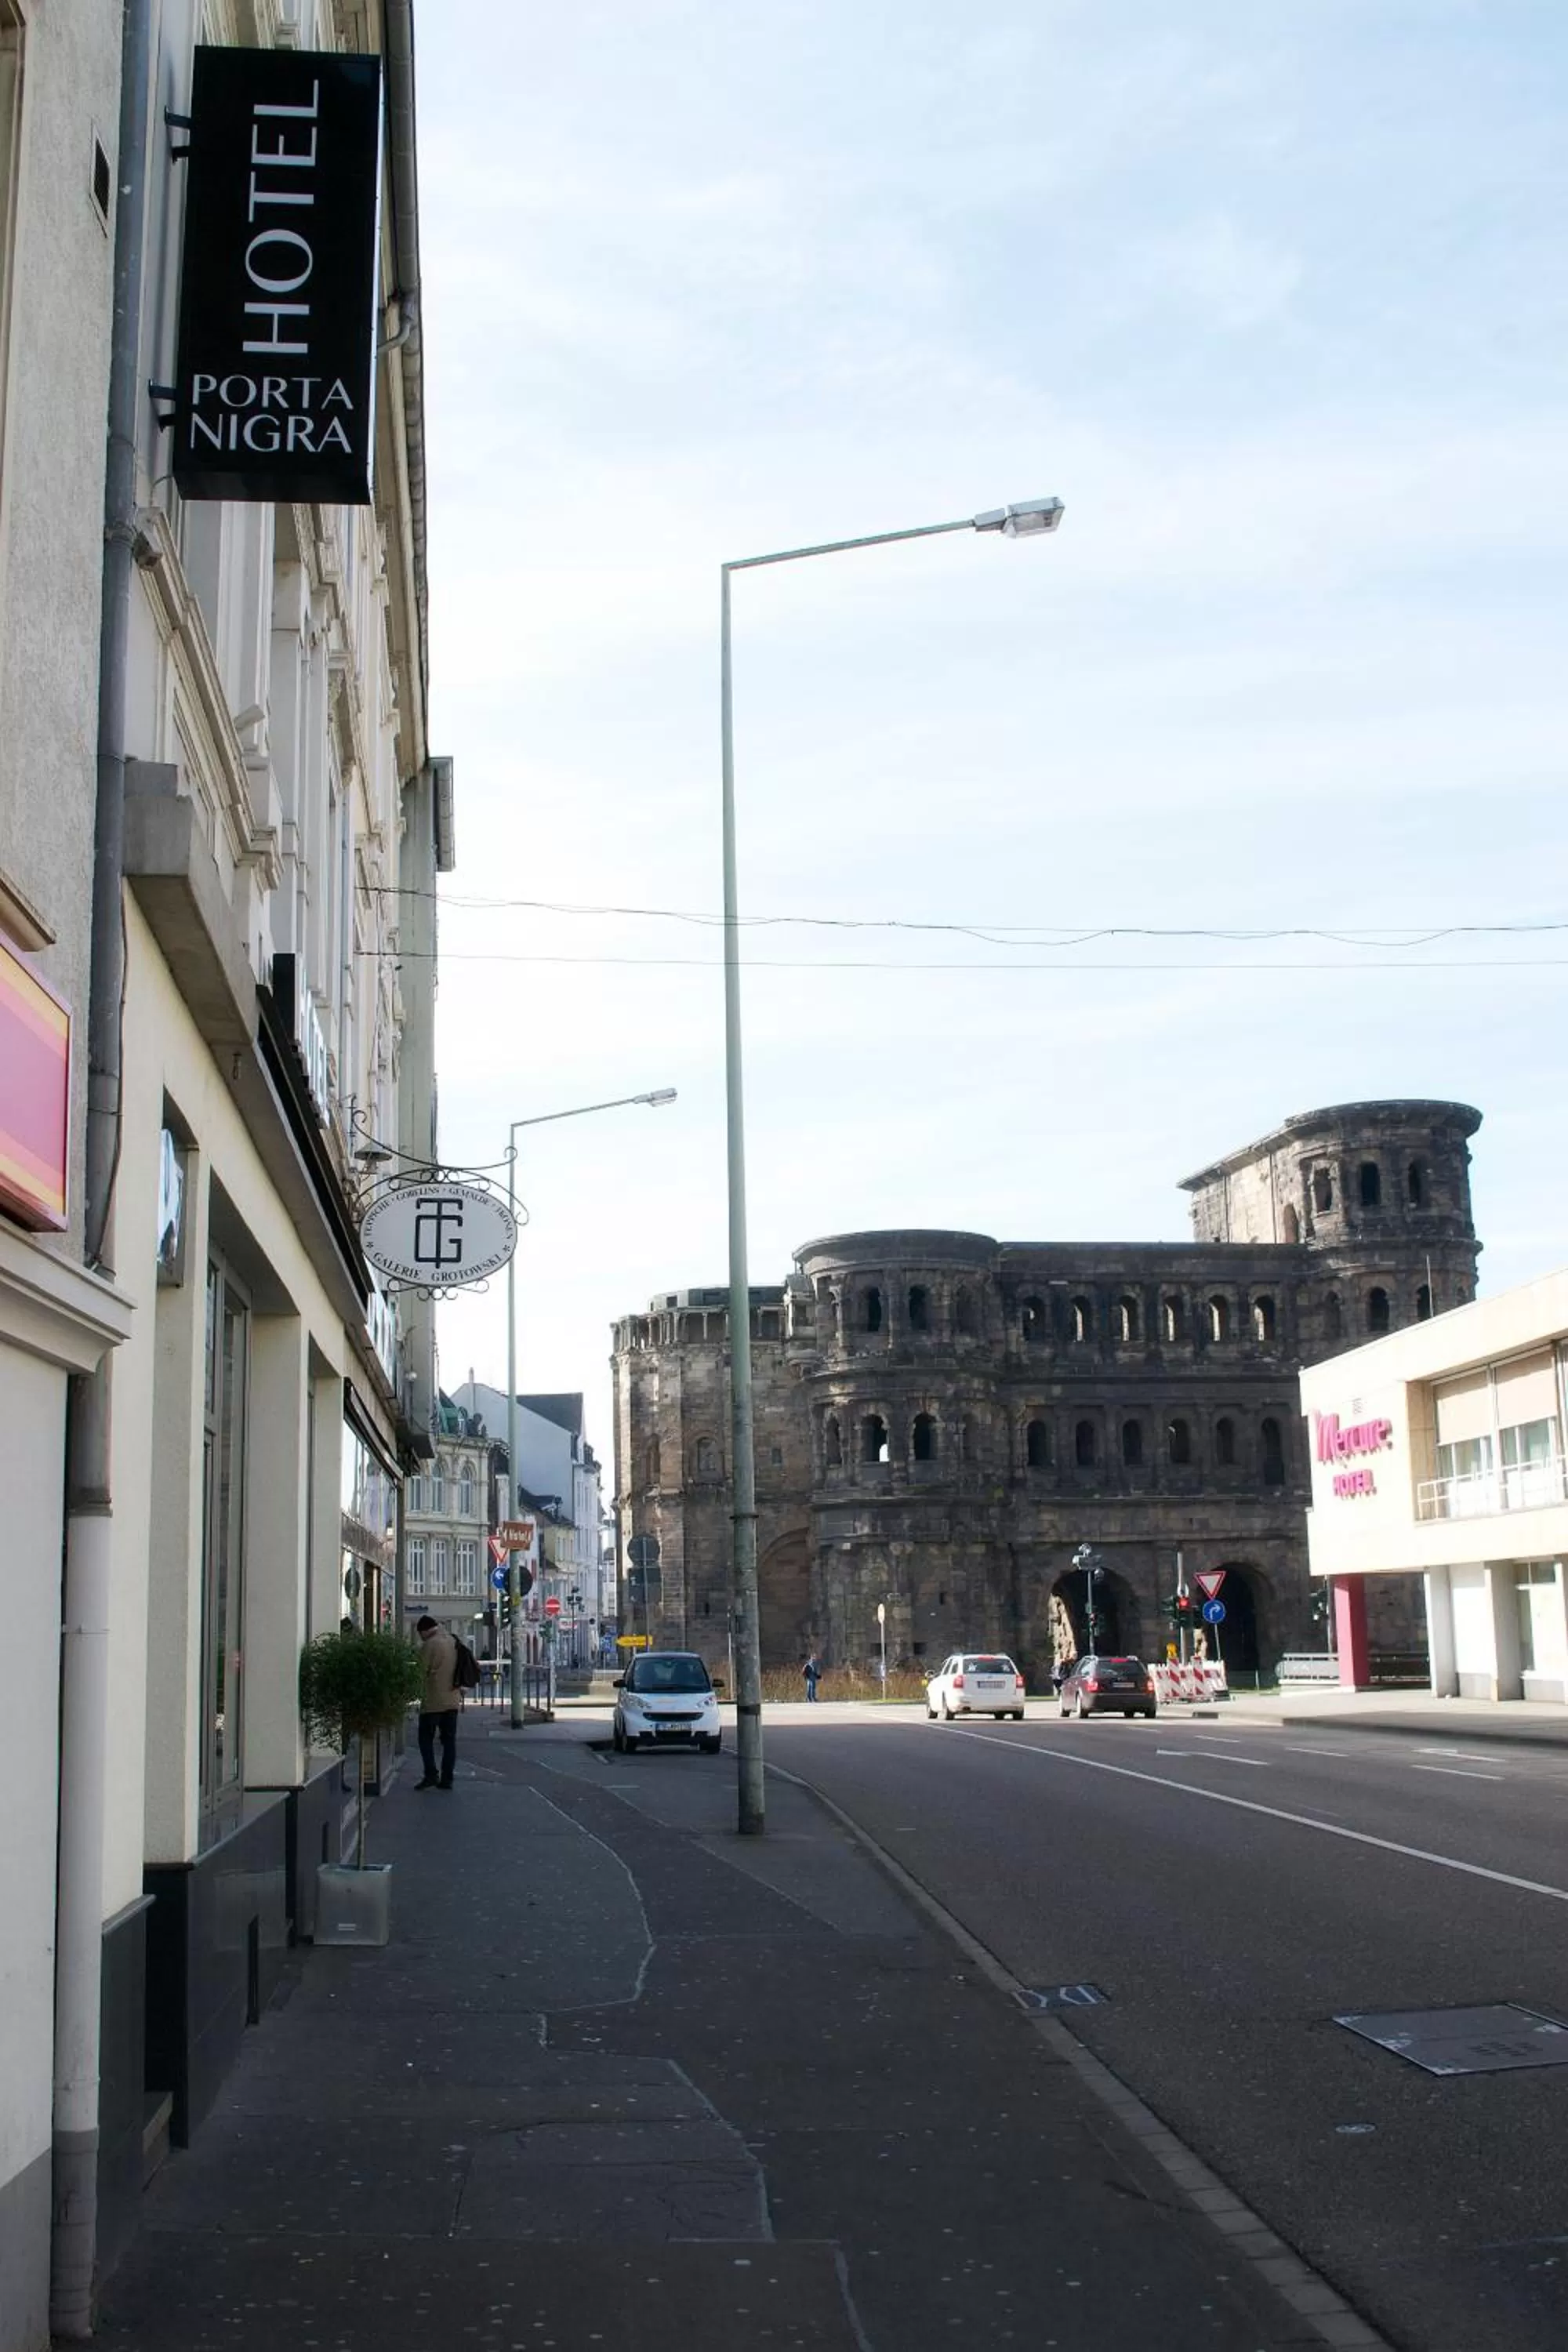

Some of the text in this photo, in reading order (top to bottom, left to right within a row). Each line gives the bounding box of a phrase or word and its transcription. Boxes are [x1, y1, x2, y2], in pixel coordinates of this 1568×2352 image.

[242, 78, 319, 354] HOTEL
[191, 373, 354, 410] PORTA
[190, 412, 352, 453] NIGRA
[372, 1252, 503, 1282] GALERIE GROTOWSKI
